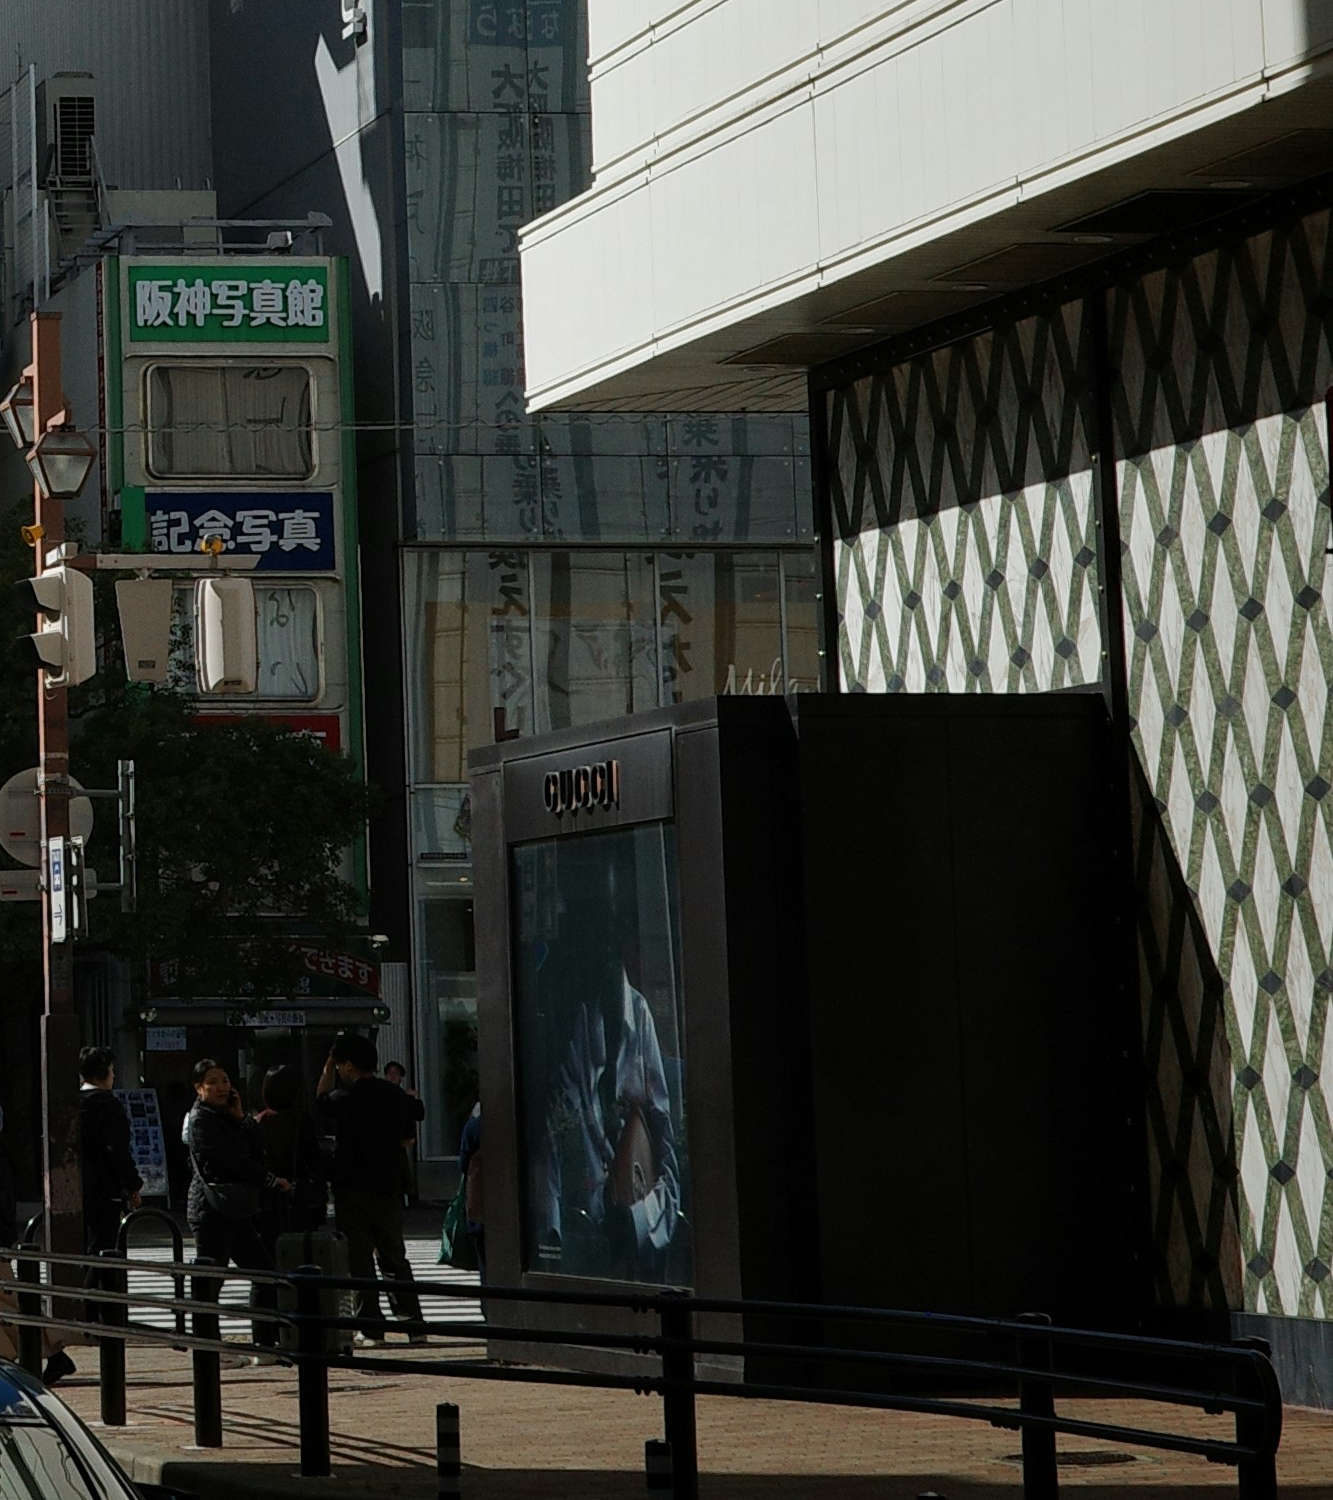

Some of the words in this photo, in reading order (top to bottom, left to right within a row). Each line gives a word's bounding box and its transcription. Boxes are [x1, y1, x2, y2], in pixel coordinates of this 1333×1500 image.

[135, 278, 324, 328] 阪神写真館
[150, 509, 321, 552] 記念写真
[544, 760, 620, 812] GUCCI
